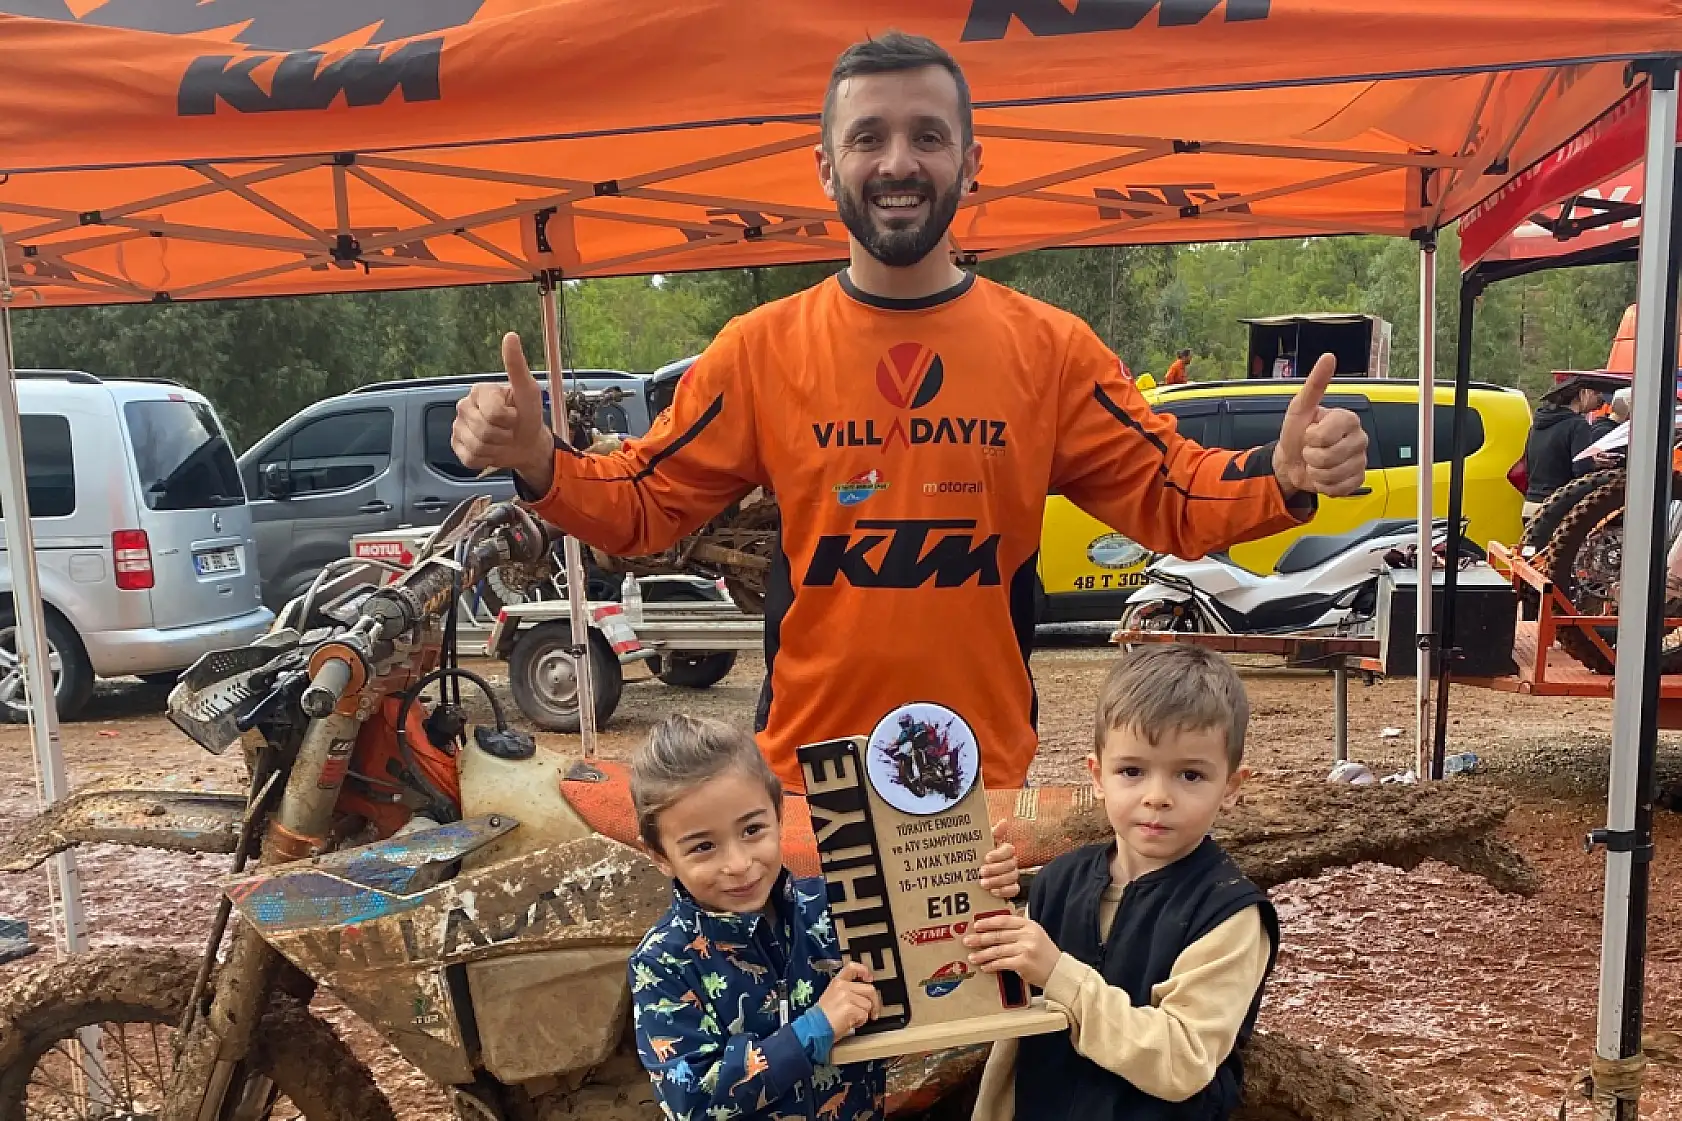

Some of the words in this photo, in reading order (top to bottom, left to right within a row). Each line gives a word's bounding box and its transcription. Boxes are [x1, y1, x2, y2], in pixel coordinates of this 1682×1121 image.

[178, 37, 444, 116] KTM
[359, 543, 402, 556] MOTUL
[802, 519, 1002, 588] KTM
[1074, 576, 1096, 589] 48
[1101, 574, 1114, 587] T
[935, 813, 972, 830] ENDURO
[904, 859, 914, 872] 3.
[916, 854, 942, 870] AYAK
[899, 875, 928, 892] 16-17
[930, 870, 964, 888] KASIM
[927, 891, 970, 919] E1B
